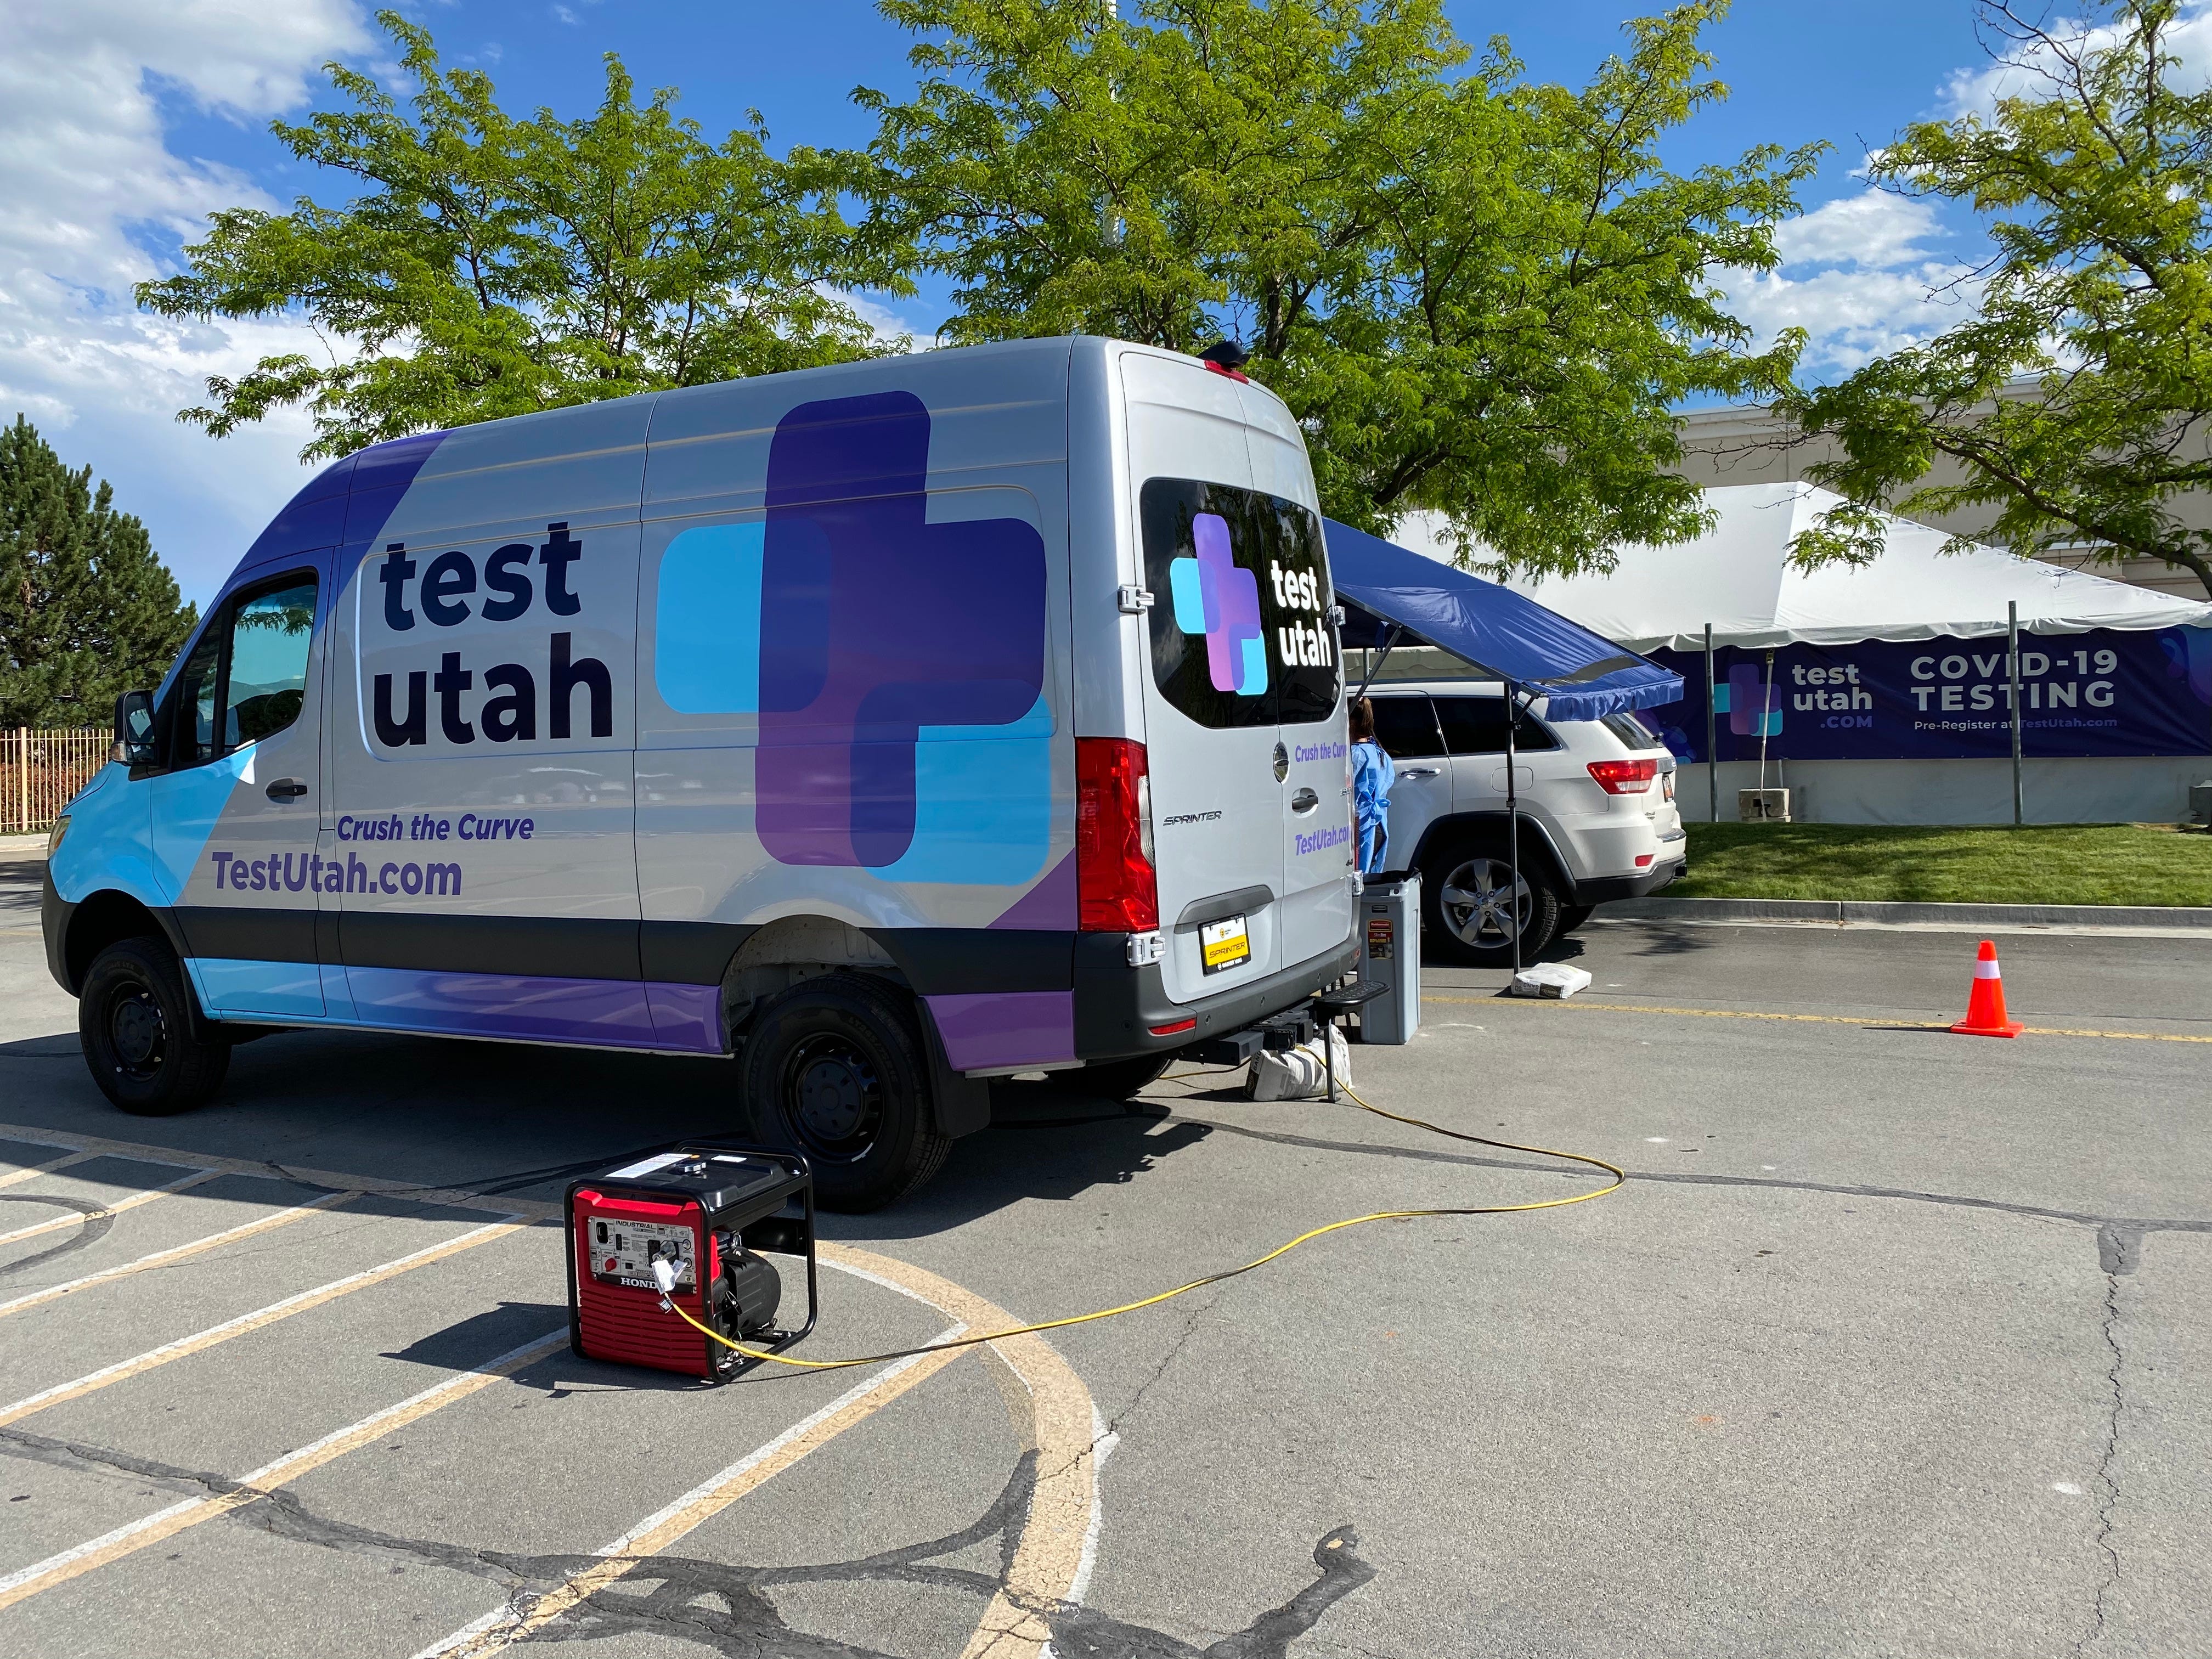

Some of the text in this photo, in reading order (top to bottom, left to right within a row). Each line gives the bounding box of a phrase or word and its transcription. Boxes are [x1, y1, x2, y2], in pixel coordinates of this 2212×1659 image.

[380, 522, 582, 631] test
[1271, 560, 1320, 612] test
[1279, 618, 1331, 667] utah
[1792, 664, 1860, 685] test
[1911, 650, 2118, 680] COVID-19
[374, 632, 612, 747] utah
[1794, 687, 1872, 710] utah
[1911, 681, 2114, 711] TESTING
[1820, 715, 1872, 729] .COM
[1915, 721, 1997, 731] Pre-Register
[2021, 718, 2117, 729] TestUtah.com
[1295, 742, 1347, 762] Crush the Curv
[337, 814, 534, 841] Crush the Curve
[1163, 810, 1222, 826] SPRINTER
[212, 852, 462, 895] TestUtah.com
[1209, 942, 1245, 959] SPRINTER
[616, 1220, 655, 1229] INDUSTRIAL
[620, 1277, 658, 1289] HOND
